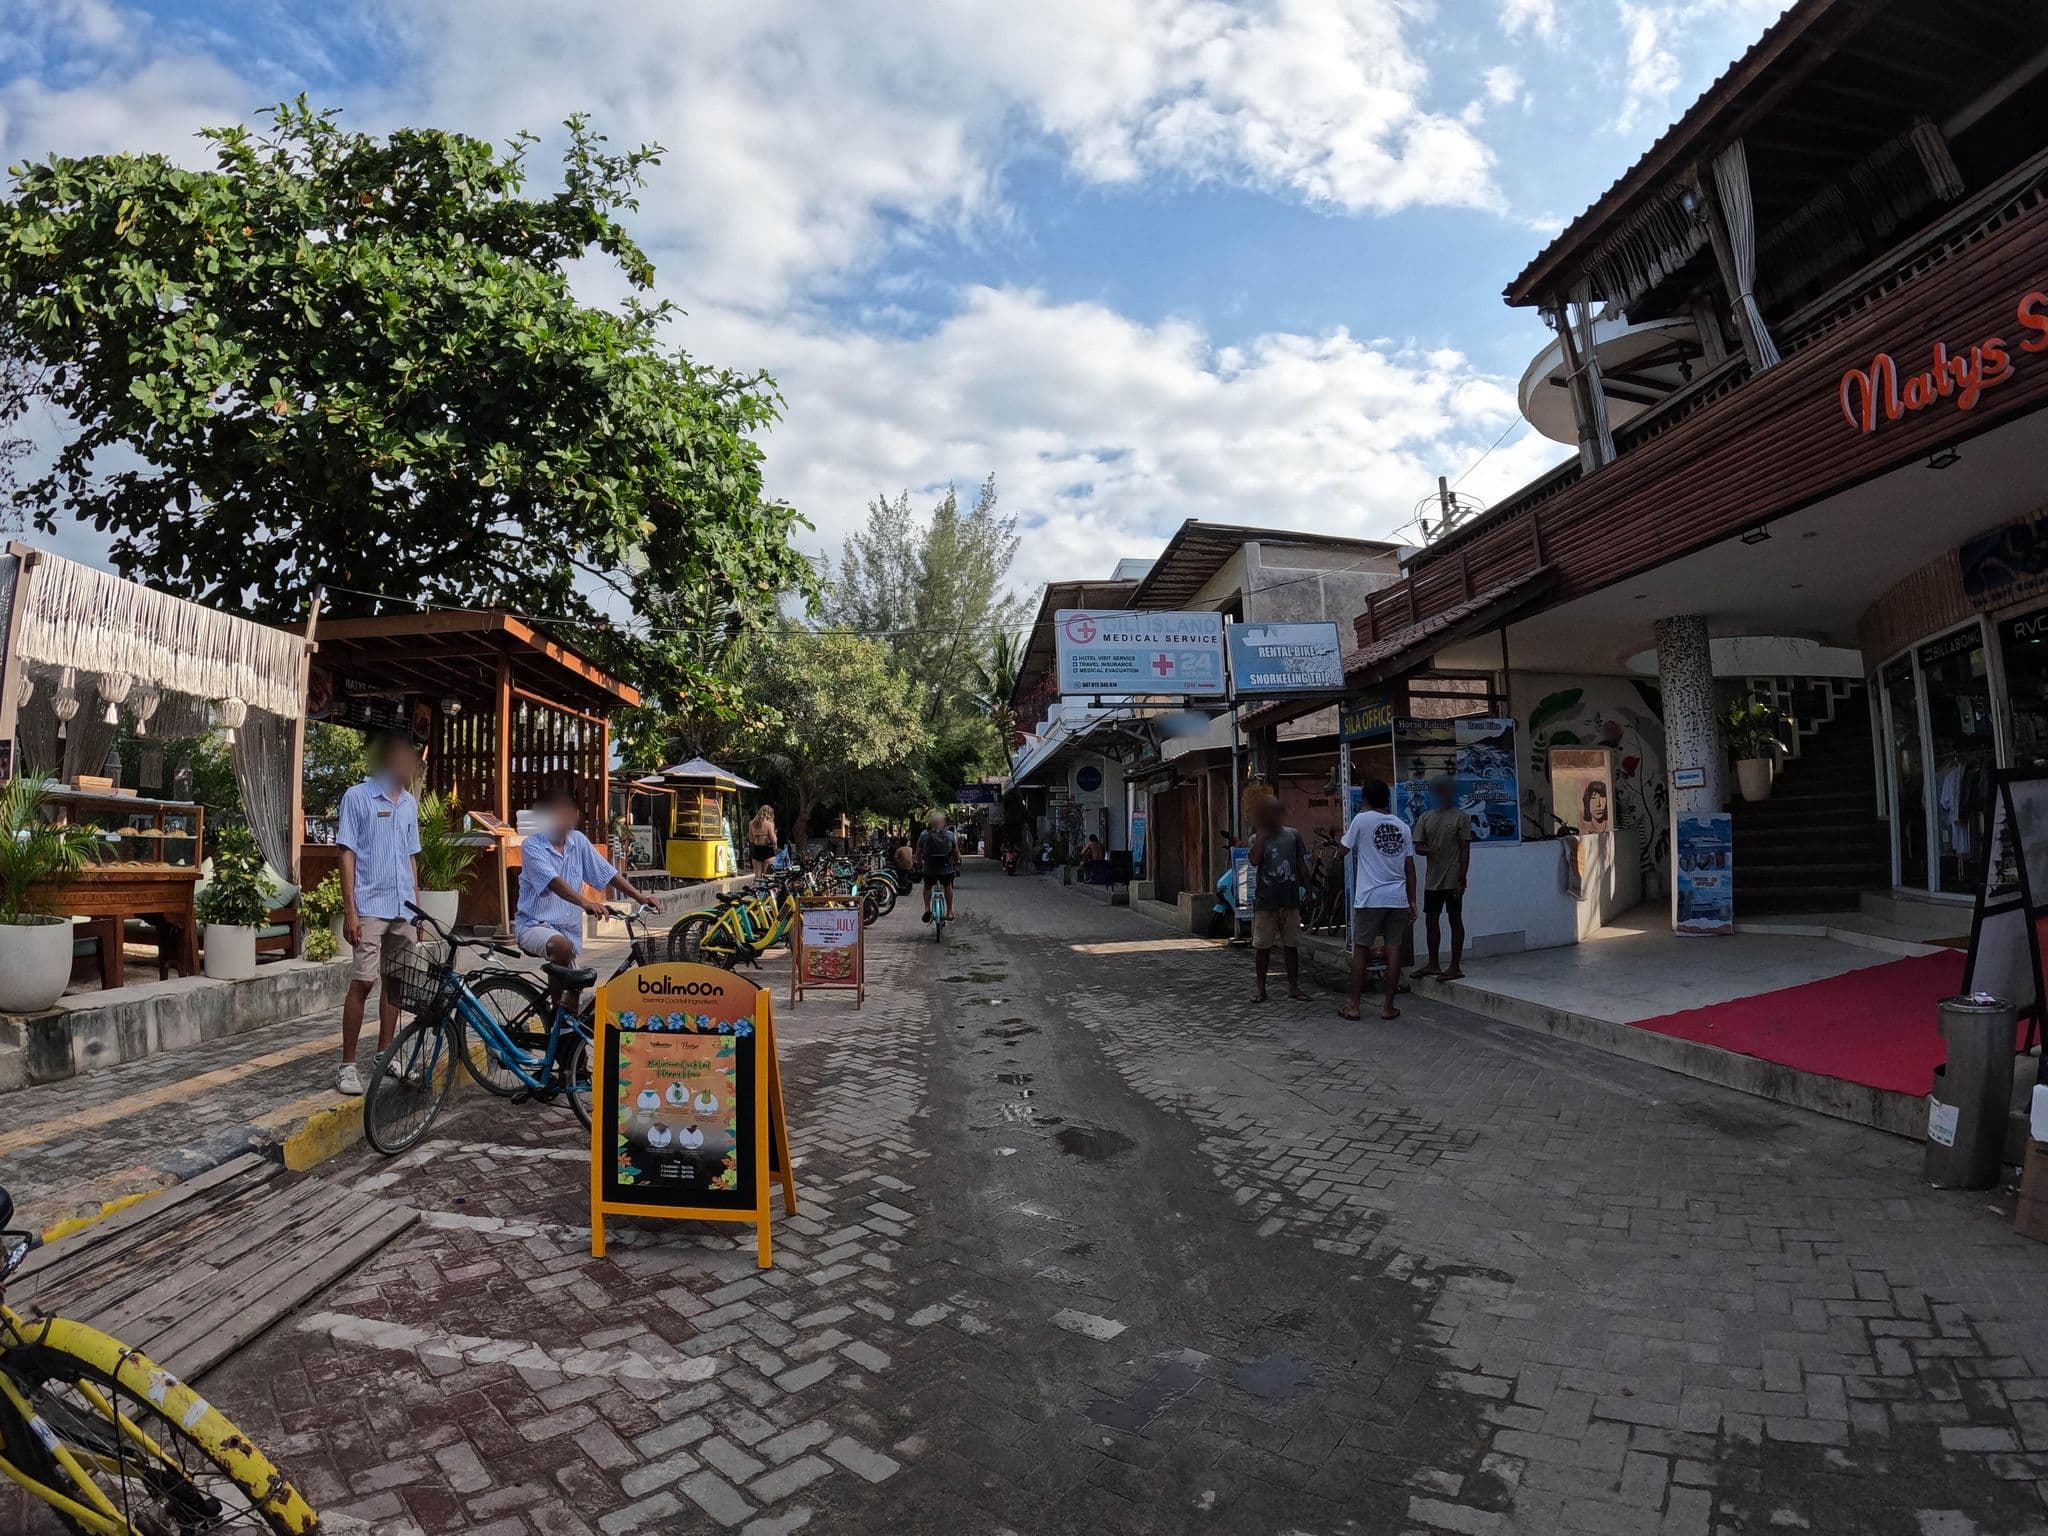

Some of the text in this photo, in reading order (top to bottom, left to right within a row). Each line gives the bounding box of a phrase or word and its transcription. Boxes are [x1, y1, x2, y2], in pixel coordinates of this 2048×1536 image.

[1103, 633, 1218, 643] MEDICAL SERVICE
[1933, 629, 1981, 659] BILLABONG
[1259, 645, 1316, 658] RENTAL BIKE
[1249, 672, 1332, 686] SNORKELING TRIP
[1344, 703, 1392, 736] SILA OFFICE
[1399, 720, 1449, 731] Horse Riding
[835, 918, 855, 931] JULY
[638, 974, 724, 996] balimoon
